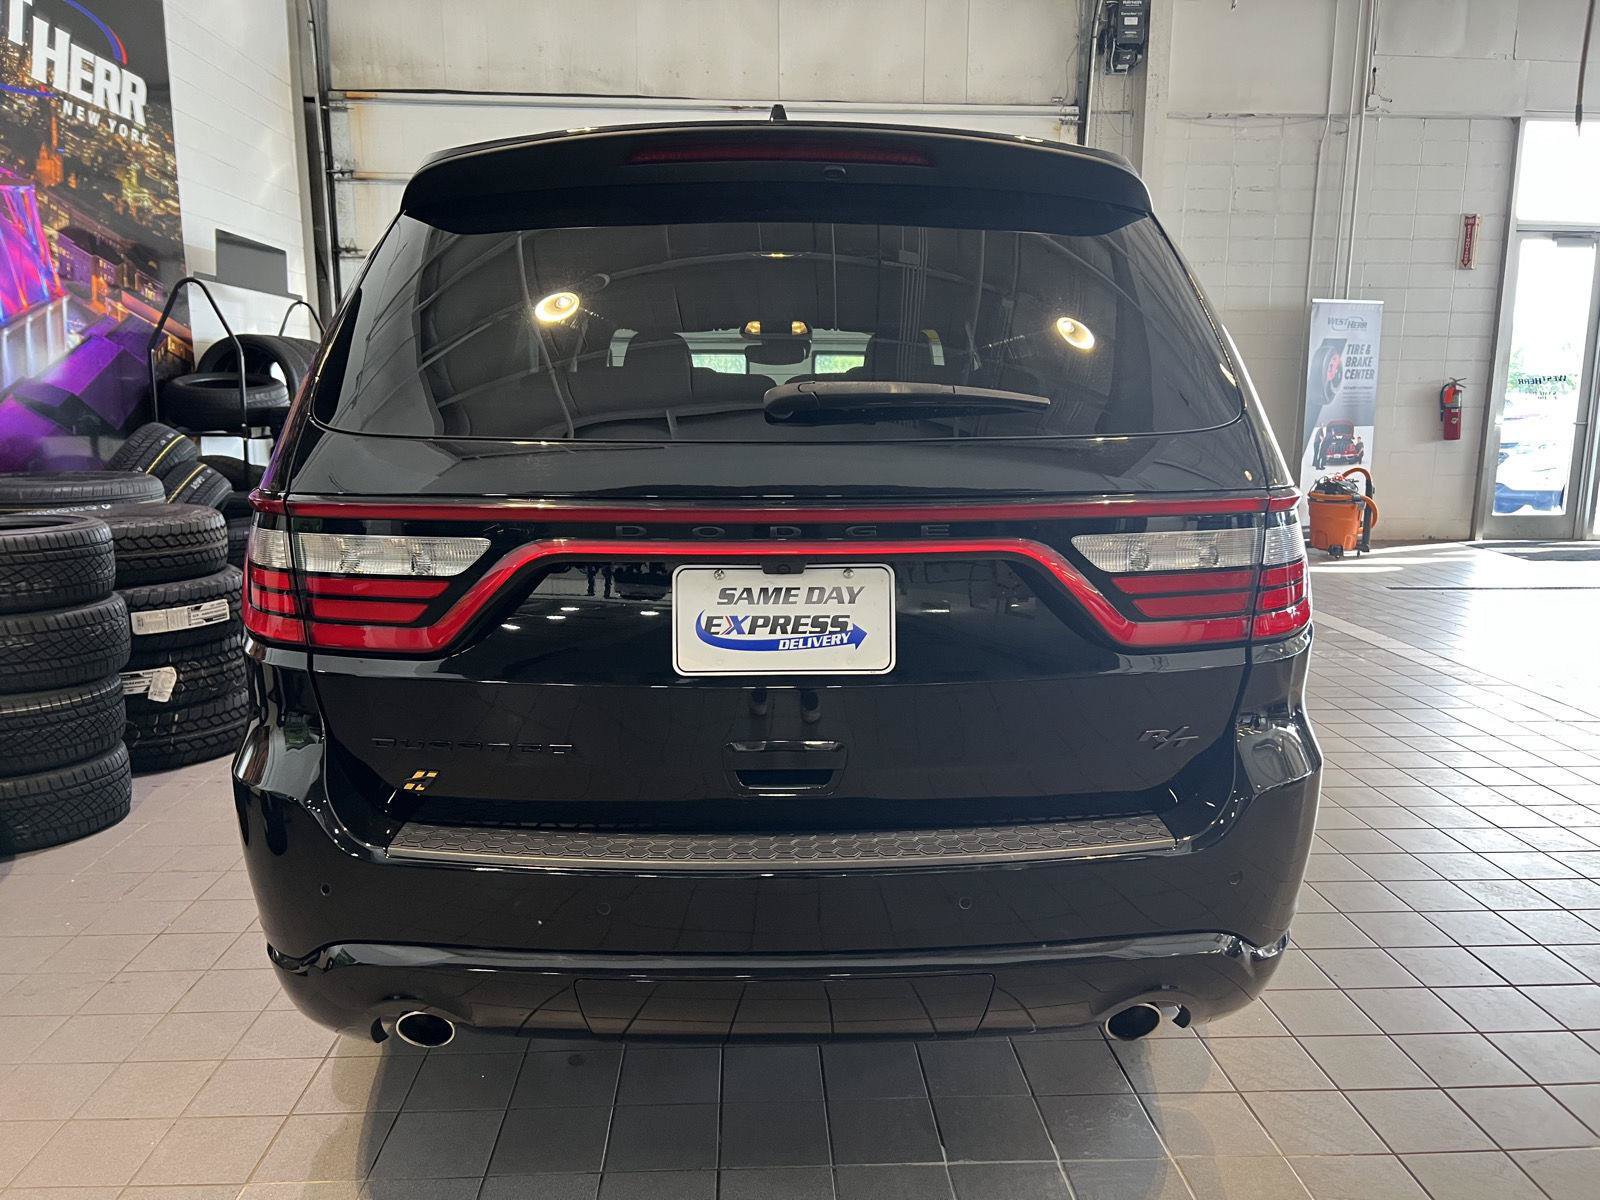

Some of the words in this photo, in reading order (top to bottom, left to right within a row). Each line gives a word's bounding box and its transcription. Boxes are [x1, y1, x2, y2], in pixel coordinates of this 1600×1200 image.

[62, 99, 101, 127] NEW
[107, 117, 150, 146] YORK
[1346, 344, 1364, 355] TIRE
[1345, 356, 1373, 367] BRAKE
[1344, 369, 1375, 380] CENTER
[615, 525, 950, 537] DODGE
[716, 586, 801, 606] SAME
[804, 586, 865, 605] DAY
[704, 614, 851, 636] EXPRESS
[778, 631, 851, 651] DELIVERY
[1137, 725, 1199, 751] R/T
